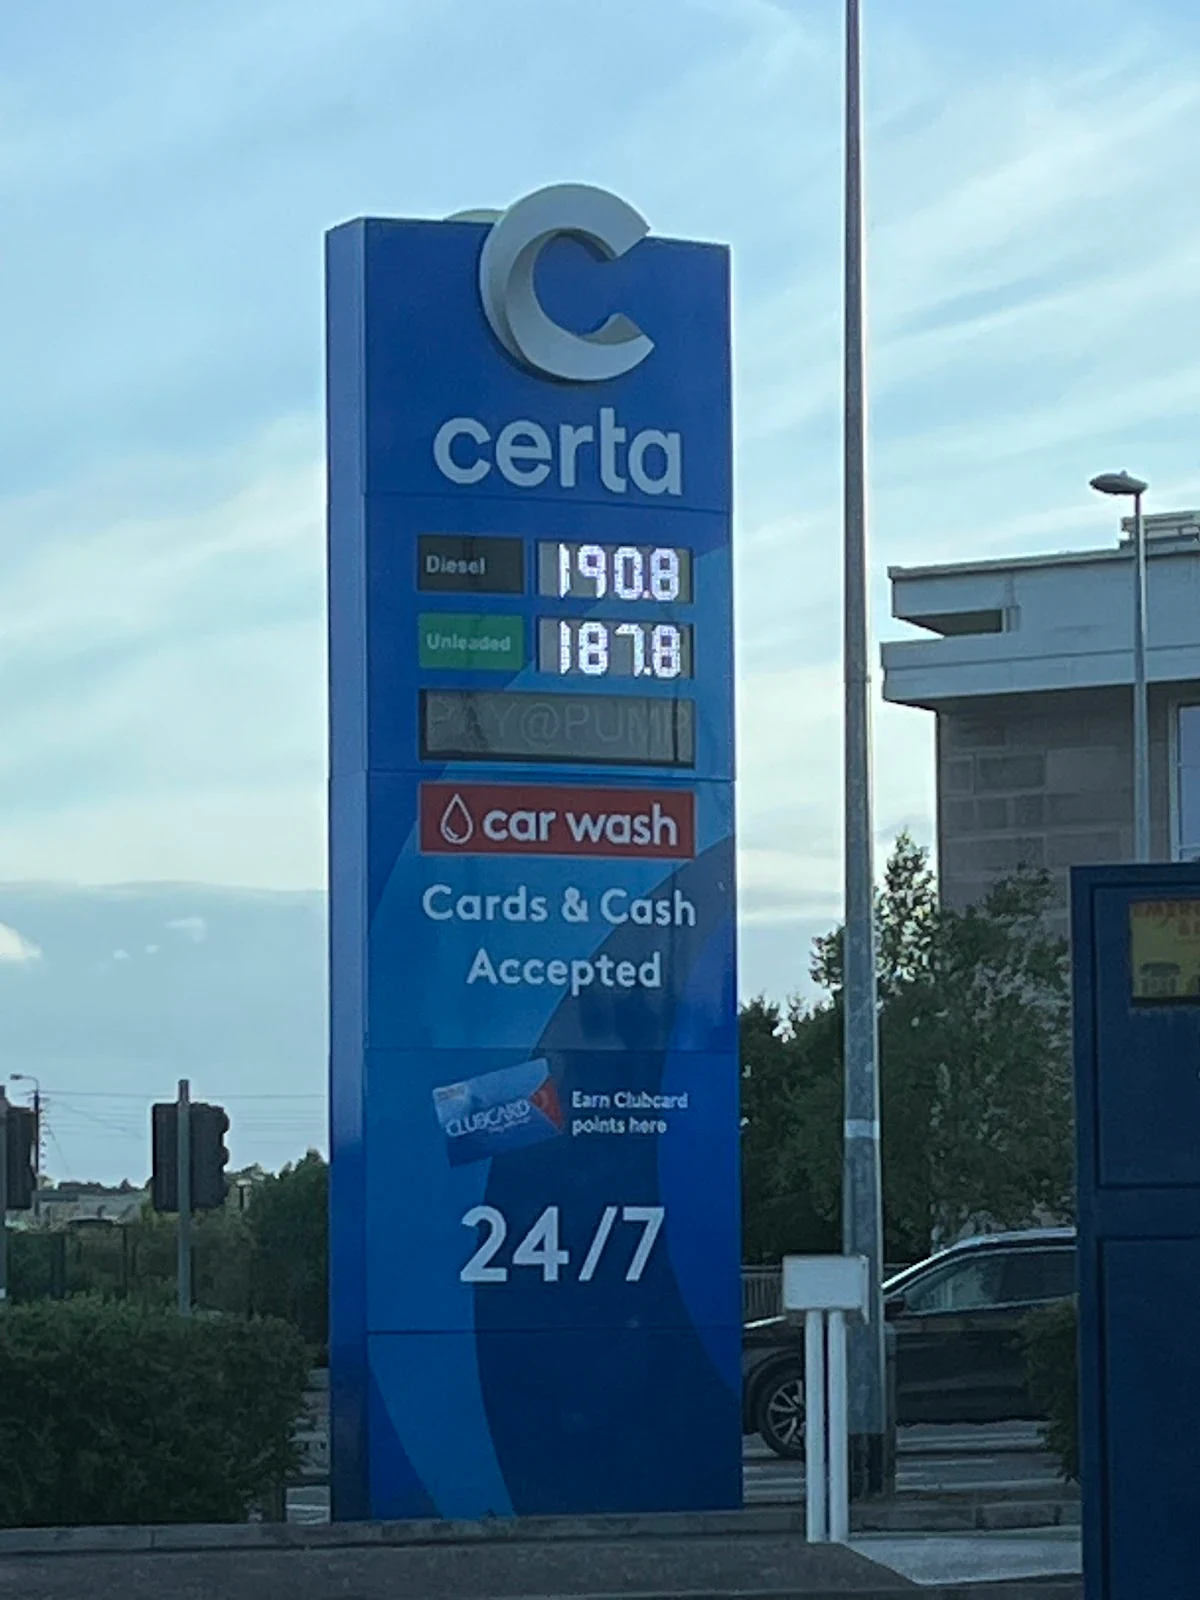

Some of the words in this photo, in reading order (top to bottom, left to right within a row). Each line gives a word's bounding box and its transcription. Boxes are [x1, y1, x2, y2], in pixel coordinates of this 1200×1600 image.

[433, 407, 682, 496] certa
[426, 555, 486, 575] Diesel
[558, 543, 680, 600] 190.8
[426, 632, 511, 653] Unleaded
[559, 620, 681, 678] 187.8
[482, 809, 556, 841] car
[565, 802, 678, 847] wash
[422, 884, 548, 922] Cards
[561, 886, 589, 923] &
[600, 888, 696, 926] Cash
[466, 948, 661, 996] Accepted
[446, 1099, 531, 1137] CLUBCARD
[572, 1091, 611, 1109] Earn
[614, 1091, 689, 1109] Clubcard
[572, 1115, 626, 1137] points
[629, 1116, 667, 1134] here
[460, 1205, 666, 1282] 24/7
